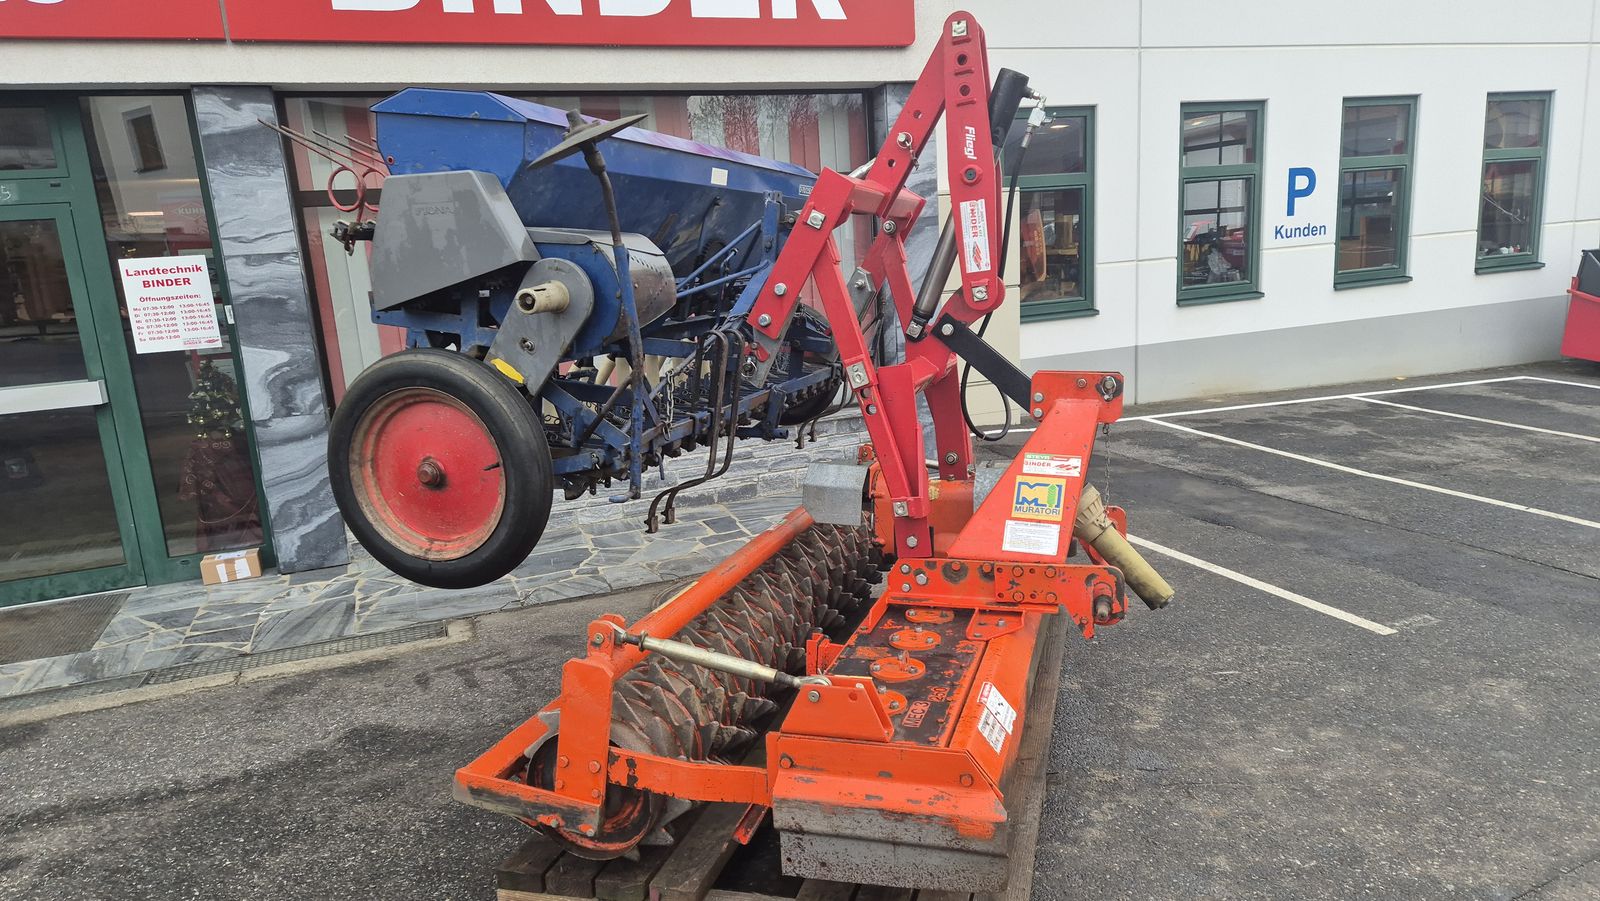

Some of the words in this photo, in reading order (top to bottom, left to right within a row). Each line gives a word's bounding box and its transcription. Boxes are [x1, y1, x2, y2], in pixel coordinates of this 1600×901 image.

[964, 126, 978, 160] Fliegl
[1287, 167, 1316, 216] P
[1274, 222, 1327, 240] Kunden
[125, 264, 203, 277] Landtechnik
[142, 277, 191, 288] BINDER
[1014, 505, 1061, 516] MURATORI
